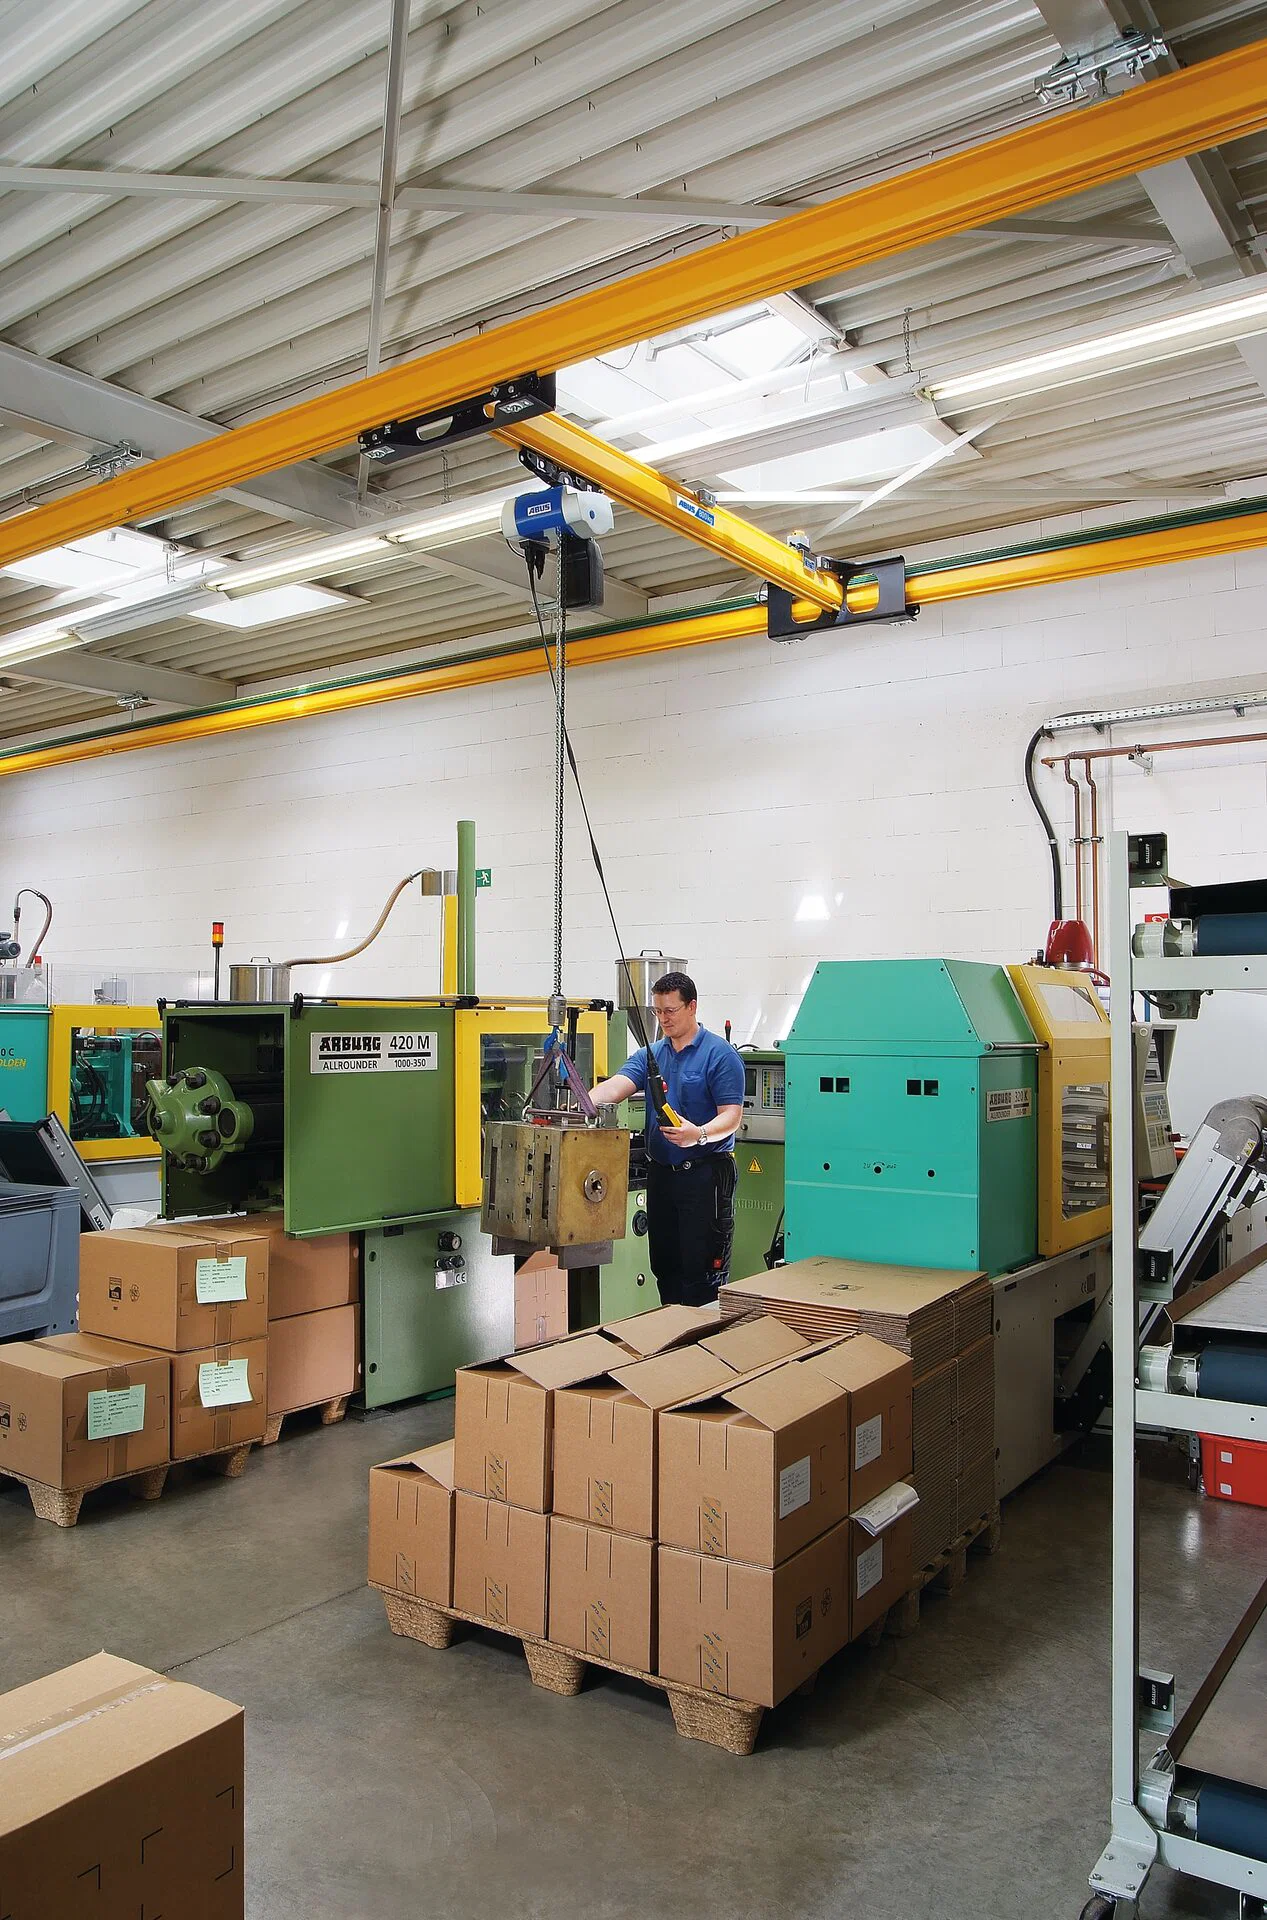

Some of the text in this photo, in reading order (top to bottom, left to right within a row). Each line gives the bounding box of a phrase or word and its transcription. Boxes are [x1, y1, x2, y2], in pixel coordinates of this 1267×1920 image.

[528, 503, 550, 515] ABUS
[679, 500, 696, 514] ABUS
[319, 1035, 430, 1052] ARBURG 420 M
[8, 1047, 15, 1057] C
[322, 1058, 427, 1070] ALLROUNDER 1000-350
